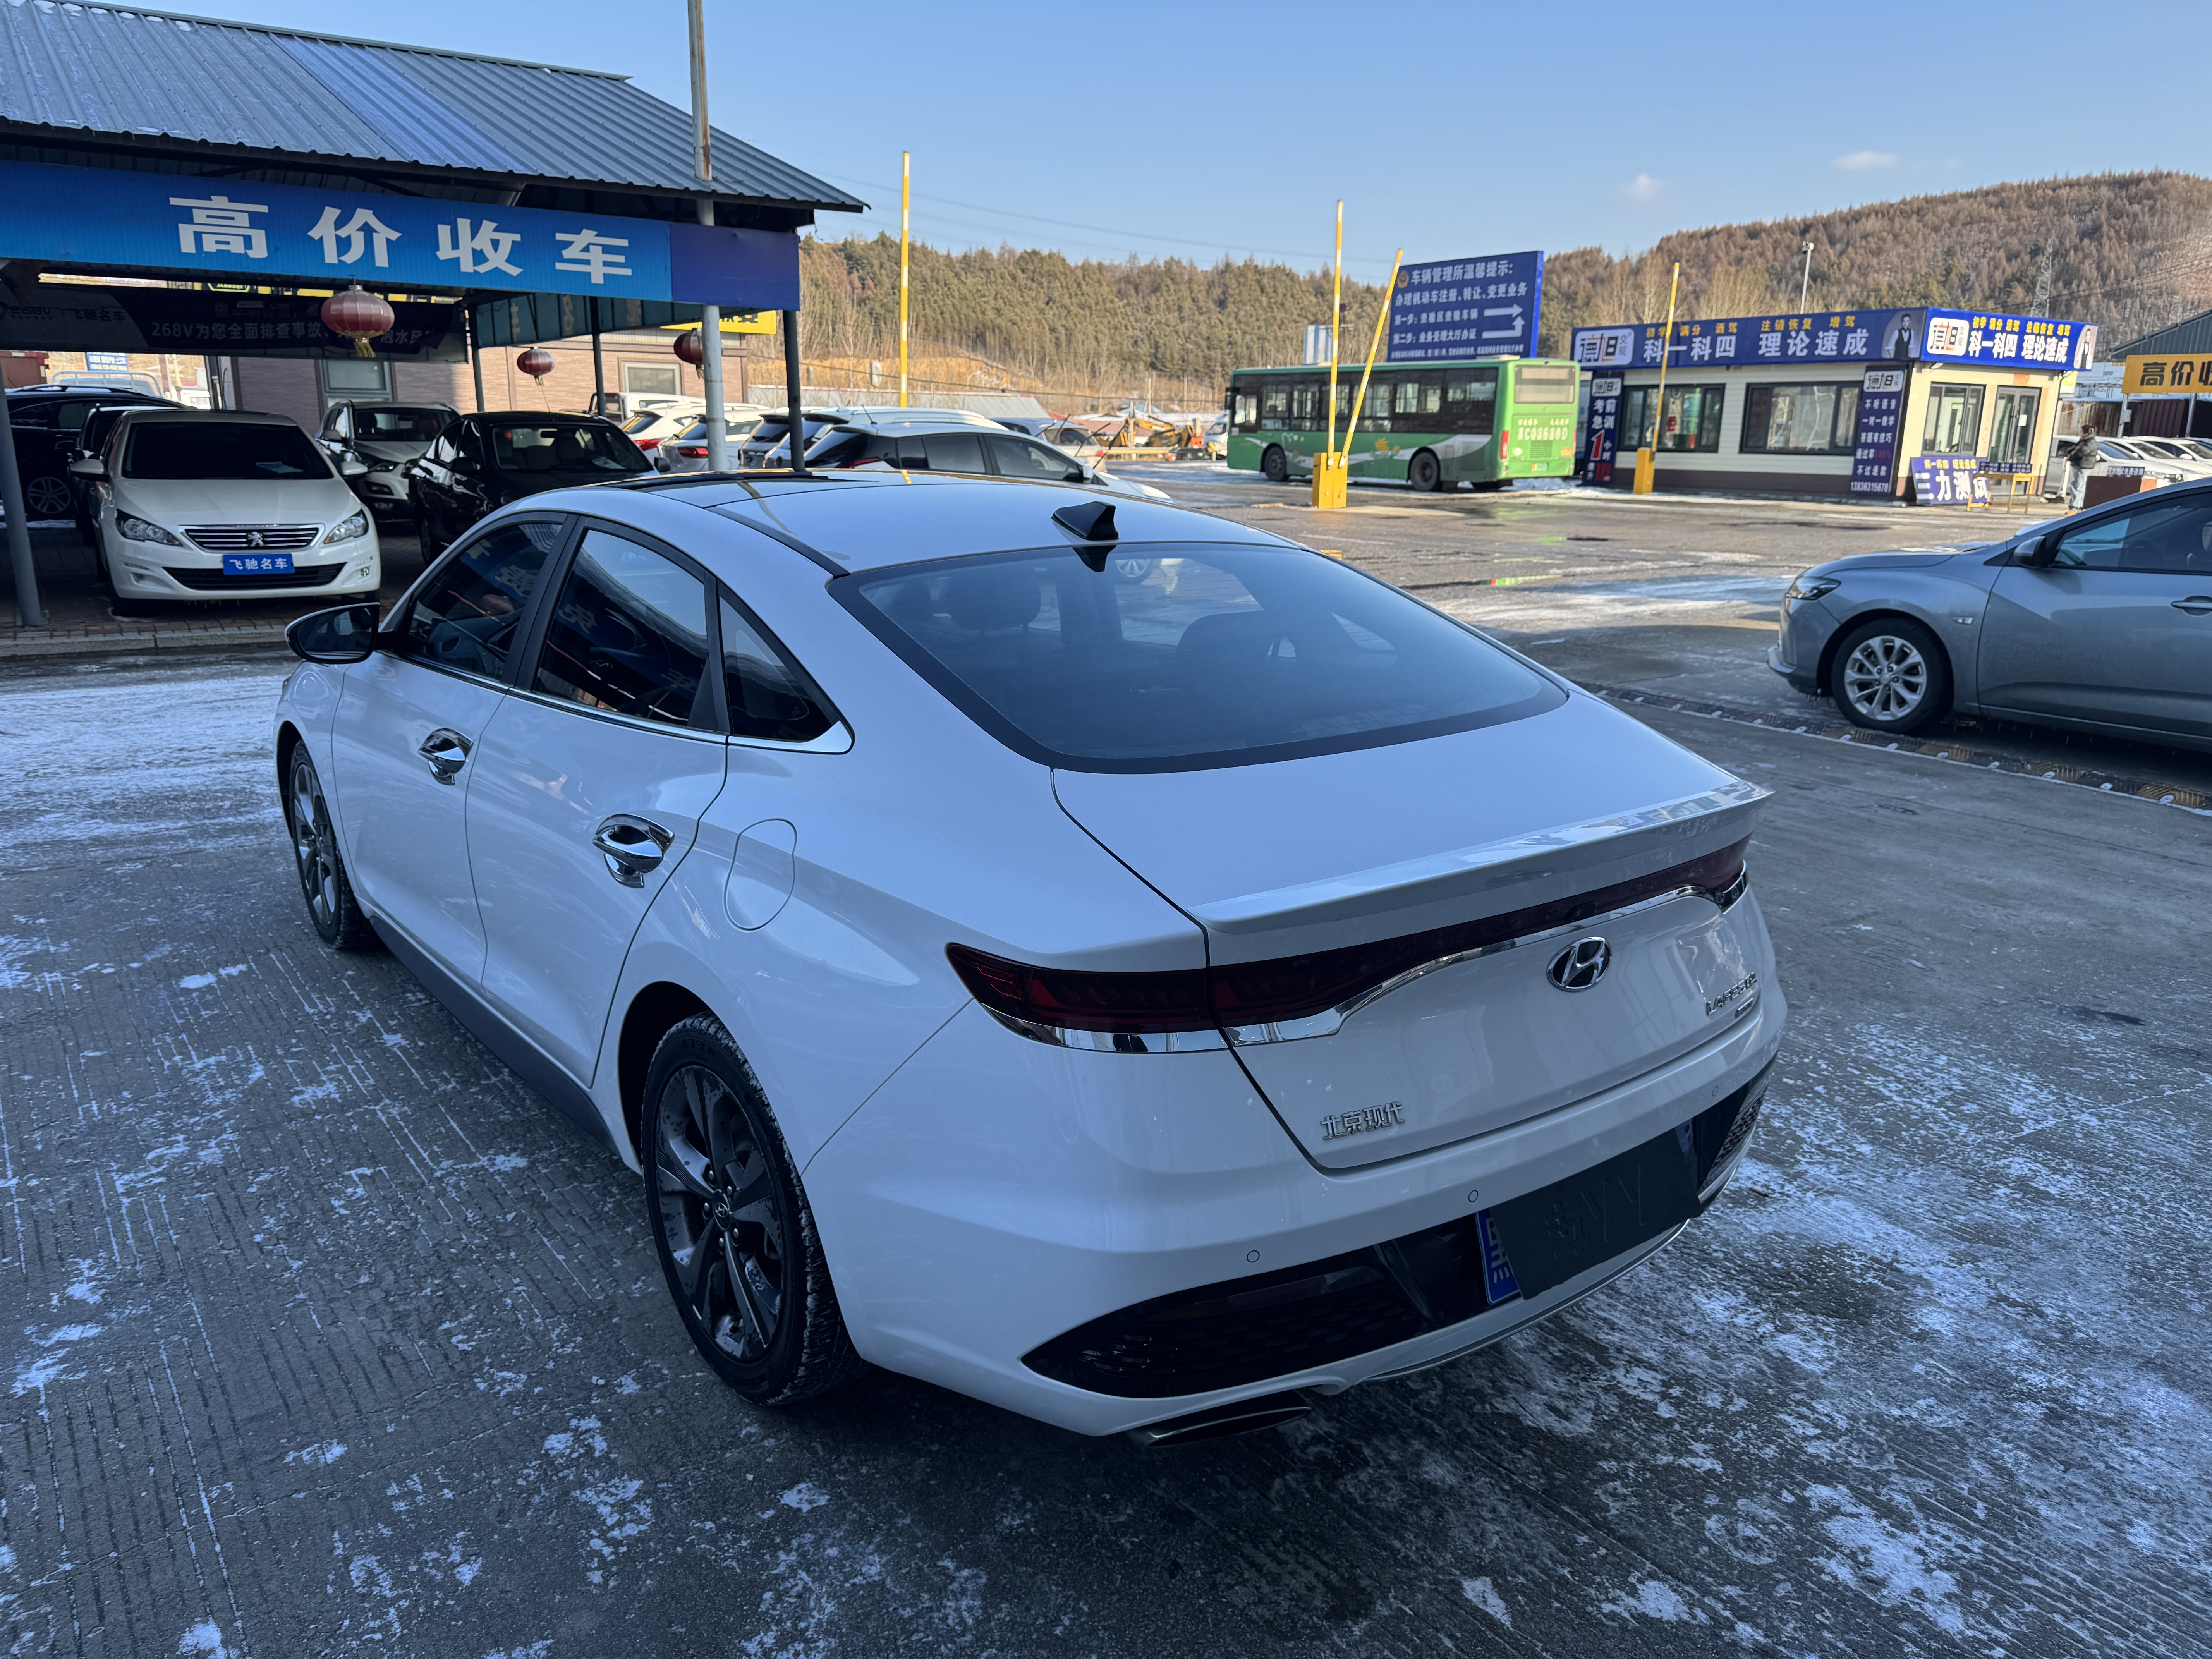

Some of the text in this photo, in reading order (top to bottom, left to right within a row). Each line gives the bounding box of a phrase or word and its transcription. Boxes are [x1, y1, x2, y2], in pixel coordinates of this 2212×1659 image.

[169, 195, 632, 284] 高价收车
[1643, 328, 1869, 363] 科一科四 理论速成
[1968, 330, 2069, 364] 科一科四 理论速成
[229, 557, 288, 570] 飞驰名车
[1320, 1101, 1405, 1141] 北京现代
